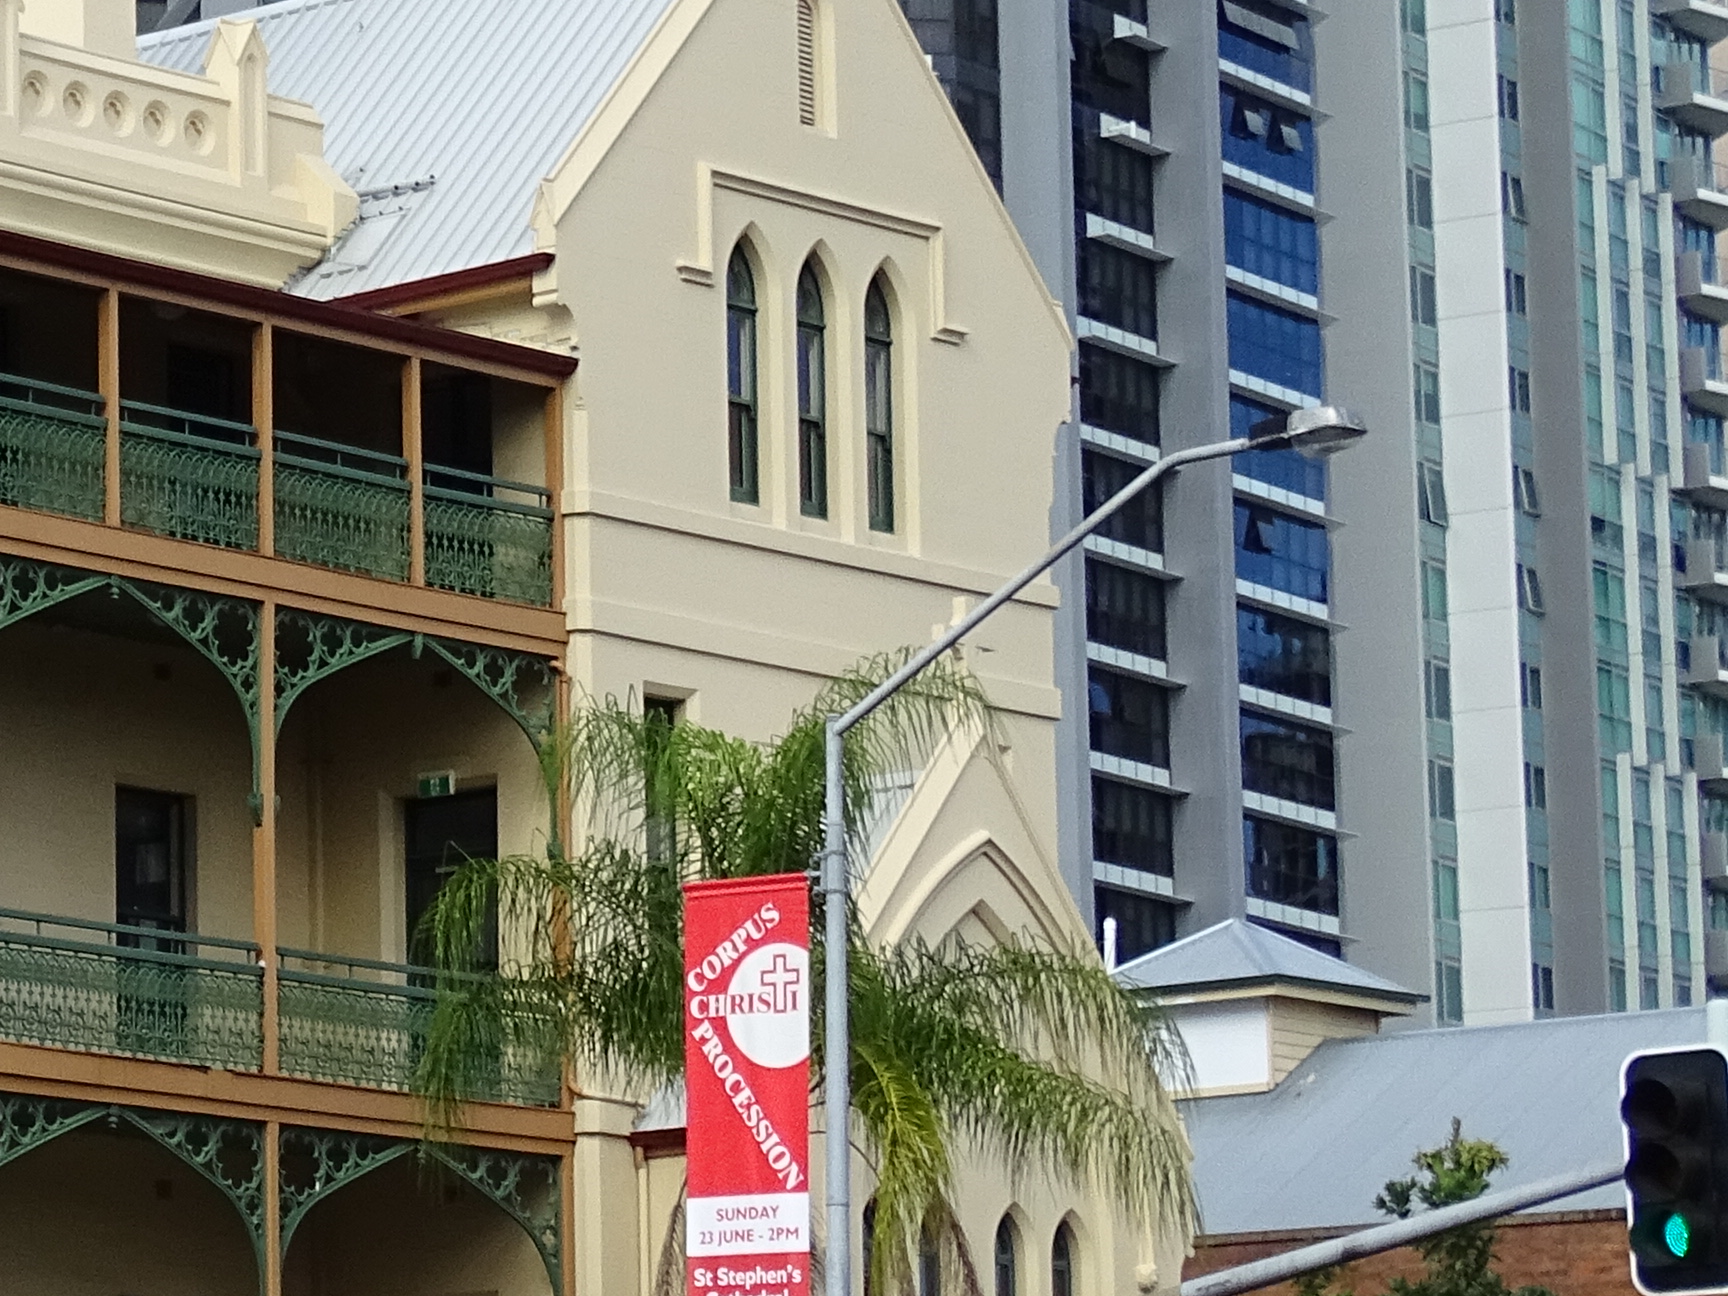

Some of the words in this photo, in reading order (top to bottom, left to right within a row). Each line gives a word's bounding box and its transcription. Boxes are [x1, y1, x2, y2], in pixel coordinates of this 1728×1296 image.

[687, 902, 781, 992] CORPUS
[689, 954, 800, 1020] CHRISTI
[691, 1019, 805, 1191] PROCESSION
[716, 1205, 779, 1222] SUNDAY
[699, 1230, 714, 1245] 23
[717, 1229, 755, 1247] JUNE
[768, 1227, 800, 1241] 2PM
[693, 1267, 714, 1287] St
[716, 1264, 802, 1290] Stephen's
